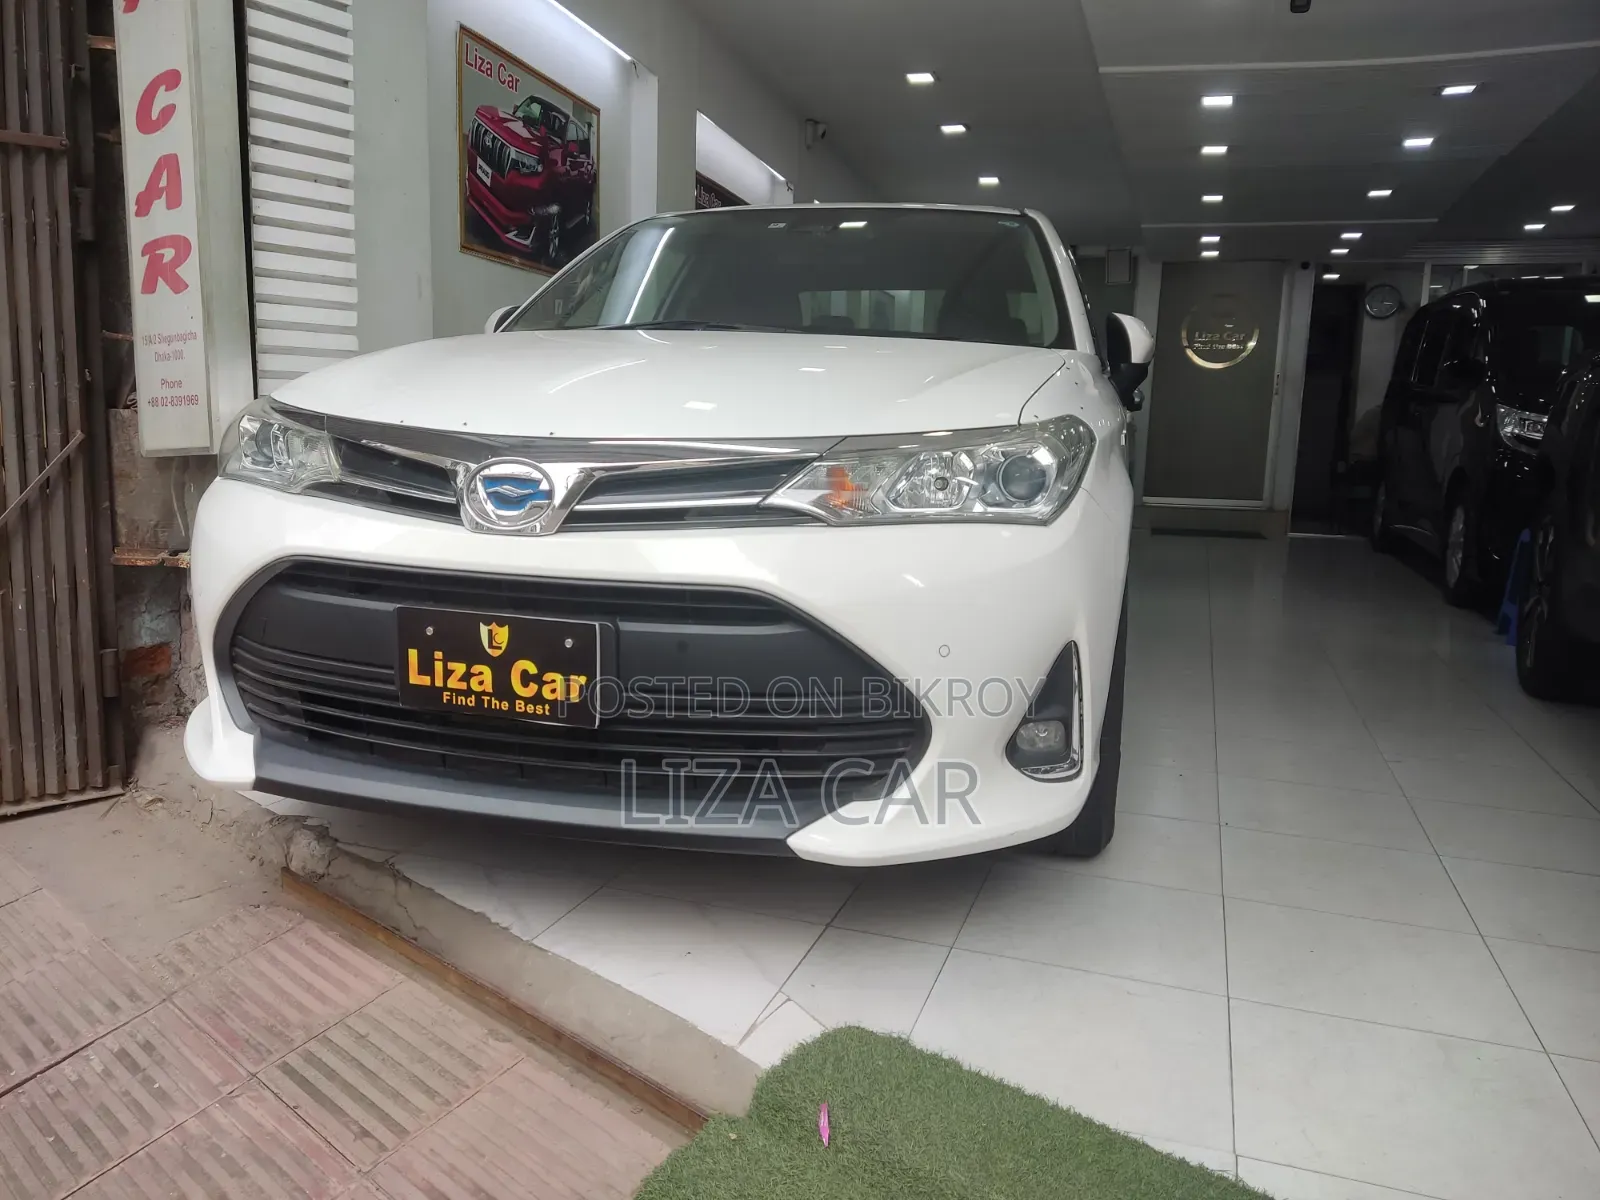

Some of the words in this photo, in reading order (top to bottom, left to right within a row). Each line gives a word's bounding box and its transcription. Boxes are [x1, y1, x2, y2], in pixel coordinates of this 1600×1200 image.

[465, 42, 493, 79] Liza
[497, 63, 520, 93] Car
[1194, 331, 1220, 341] Liza
[1223, 331, 1246, 342] Car
[160, 378, 183, 390] Phone
[407, 648, 494, 693] Liza
[510, 659, 588, 703] Car
[442, 691, 476, 708] Find
[481, 695, 509, 711] The
[515, 701, 551, 716] Best
